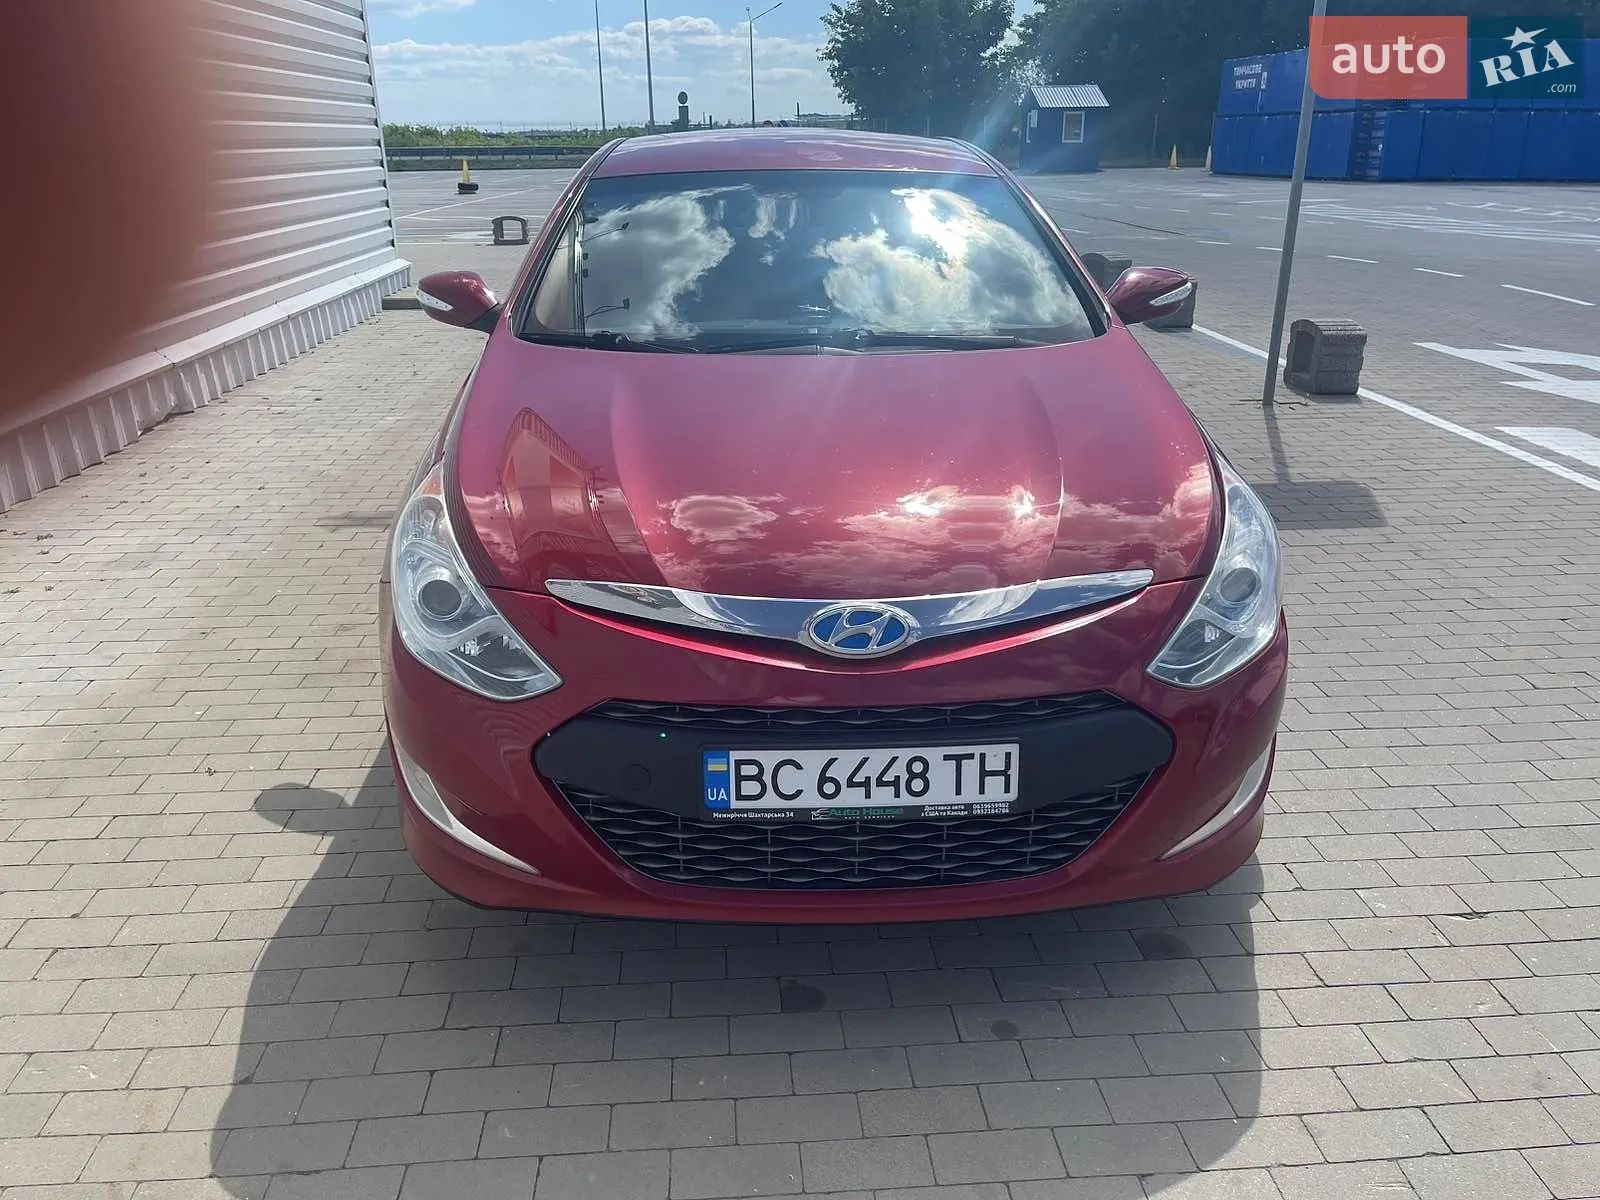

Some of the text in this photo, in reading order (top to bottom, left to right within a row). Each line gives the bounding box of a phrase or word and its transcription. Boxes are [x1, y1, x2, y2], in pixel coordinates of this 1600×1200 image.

[733, 751, 1013, 801] BC 6448 TH
[707, 787, 728, 801] UA
[747, 811, 785, 819] Шахтарська
[829, 807, 860, 816] Auto
